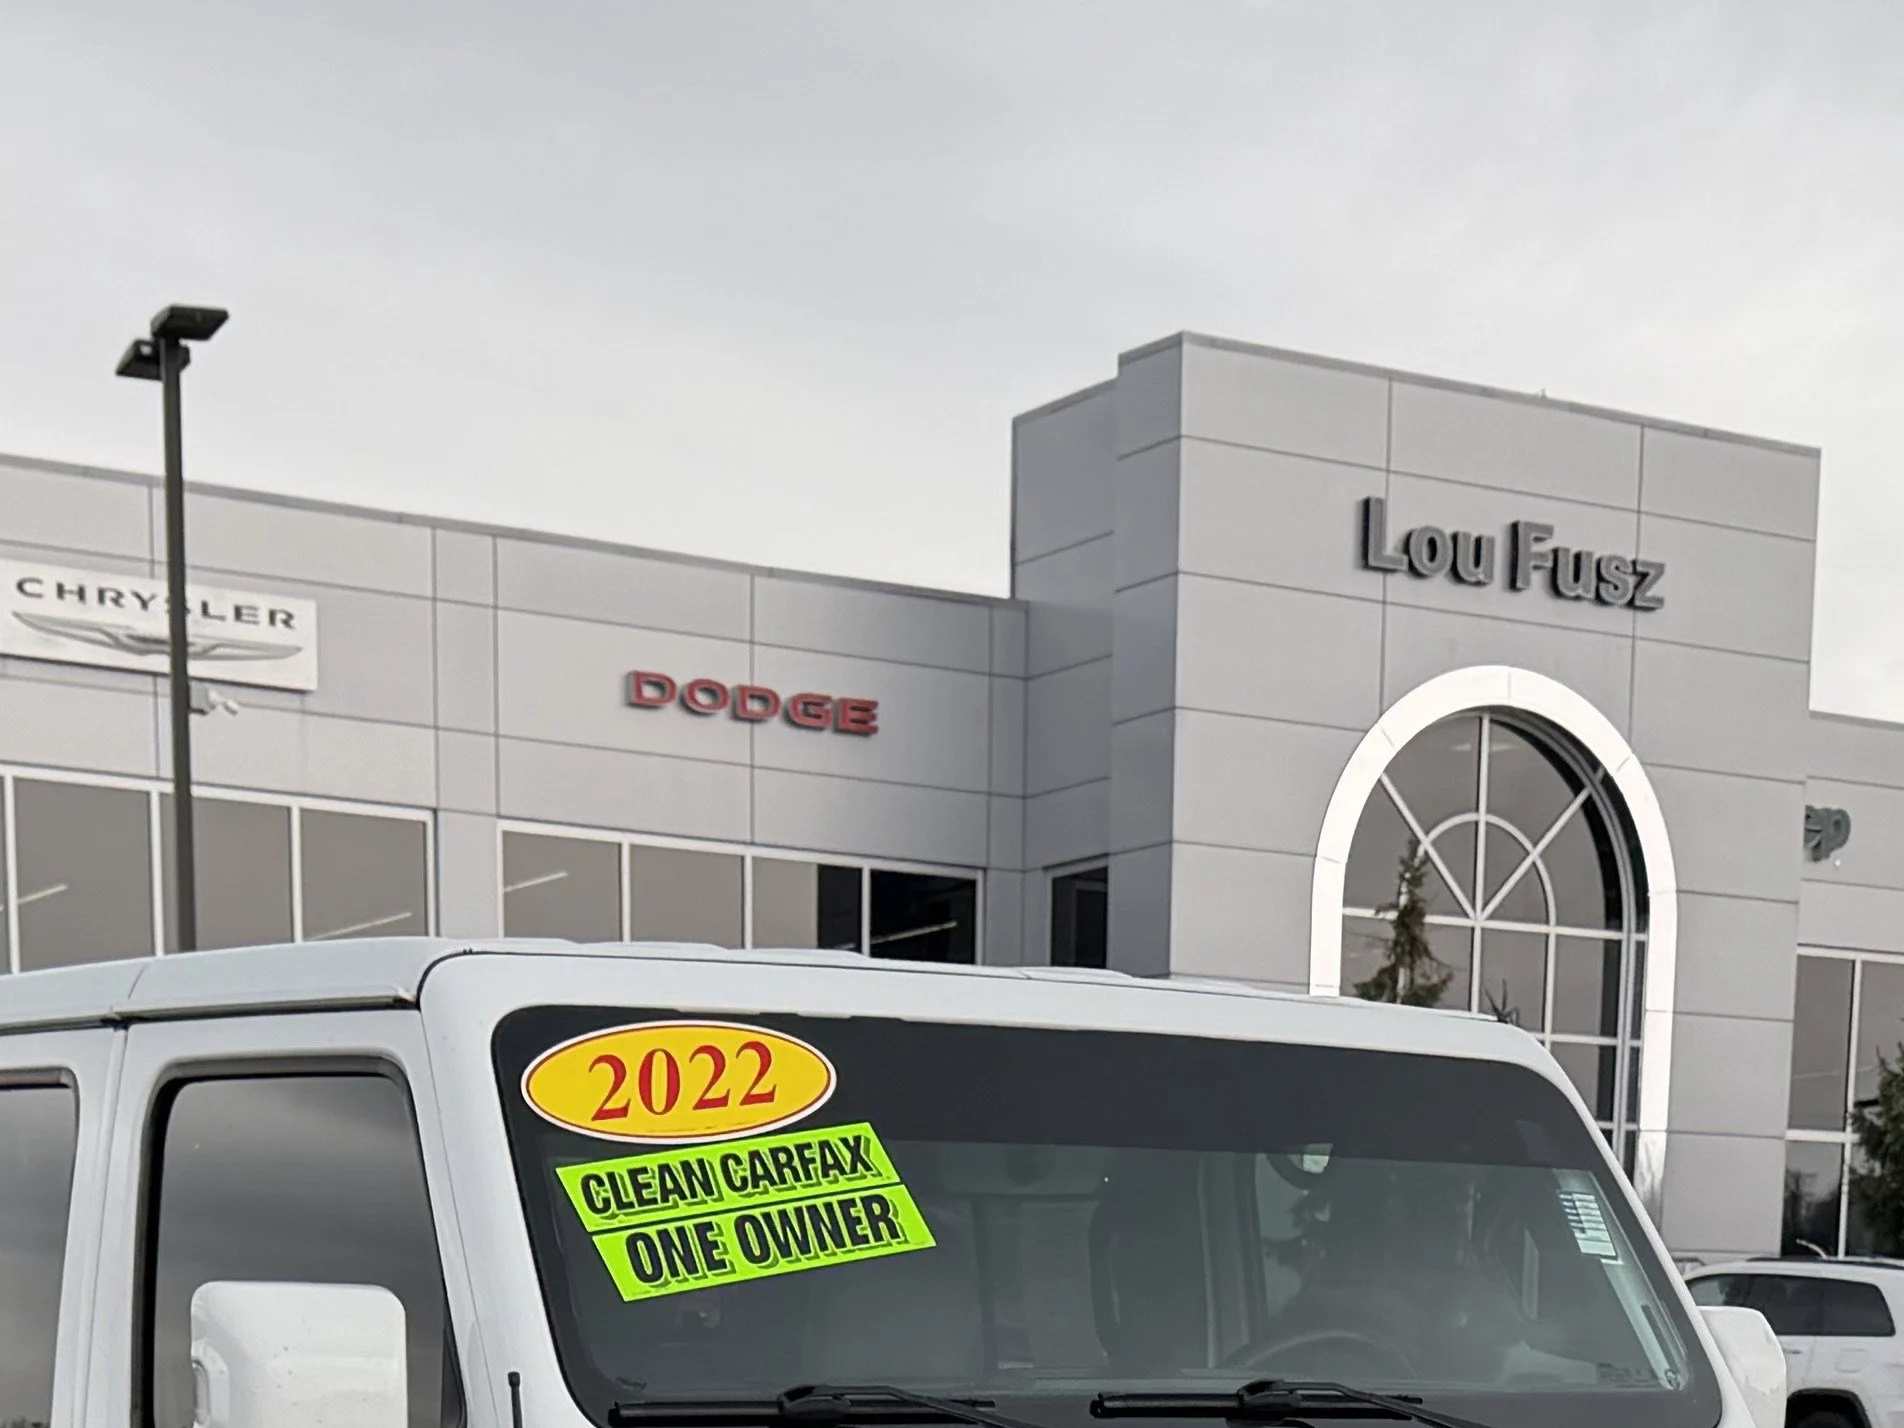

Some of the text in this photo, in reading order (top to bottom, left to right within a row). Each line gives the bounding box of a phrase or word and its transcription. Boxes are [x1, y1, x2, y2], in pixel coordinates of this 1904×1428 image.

[1360, 496, 1666, 611] Lou Fusz
[15, 576, 297, 630] CHRYLER
[626, 669, 879, 738] DODGE
[588, 1040, 778, 1122] 2022
[580, 1134, 878, 1219] CLEAN CARFAX
[624, 1193, 905, 1286] ONE OWNER
